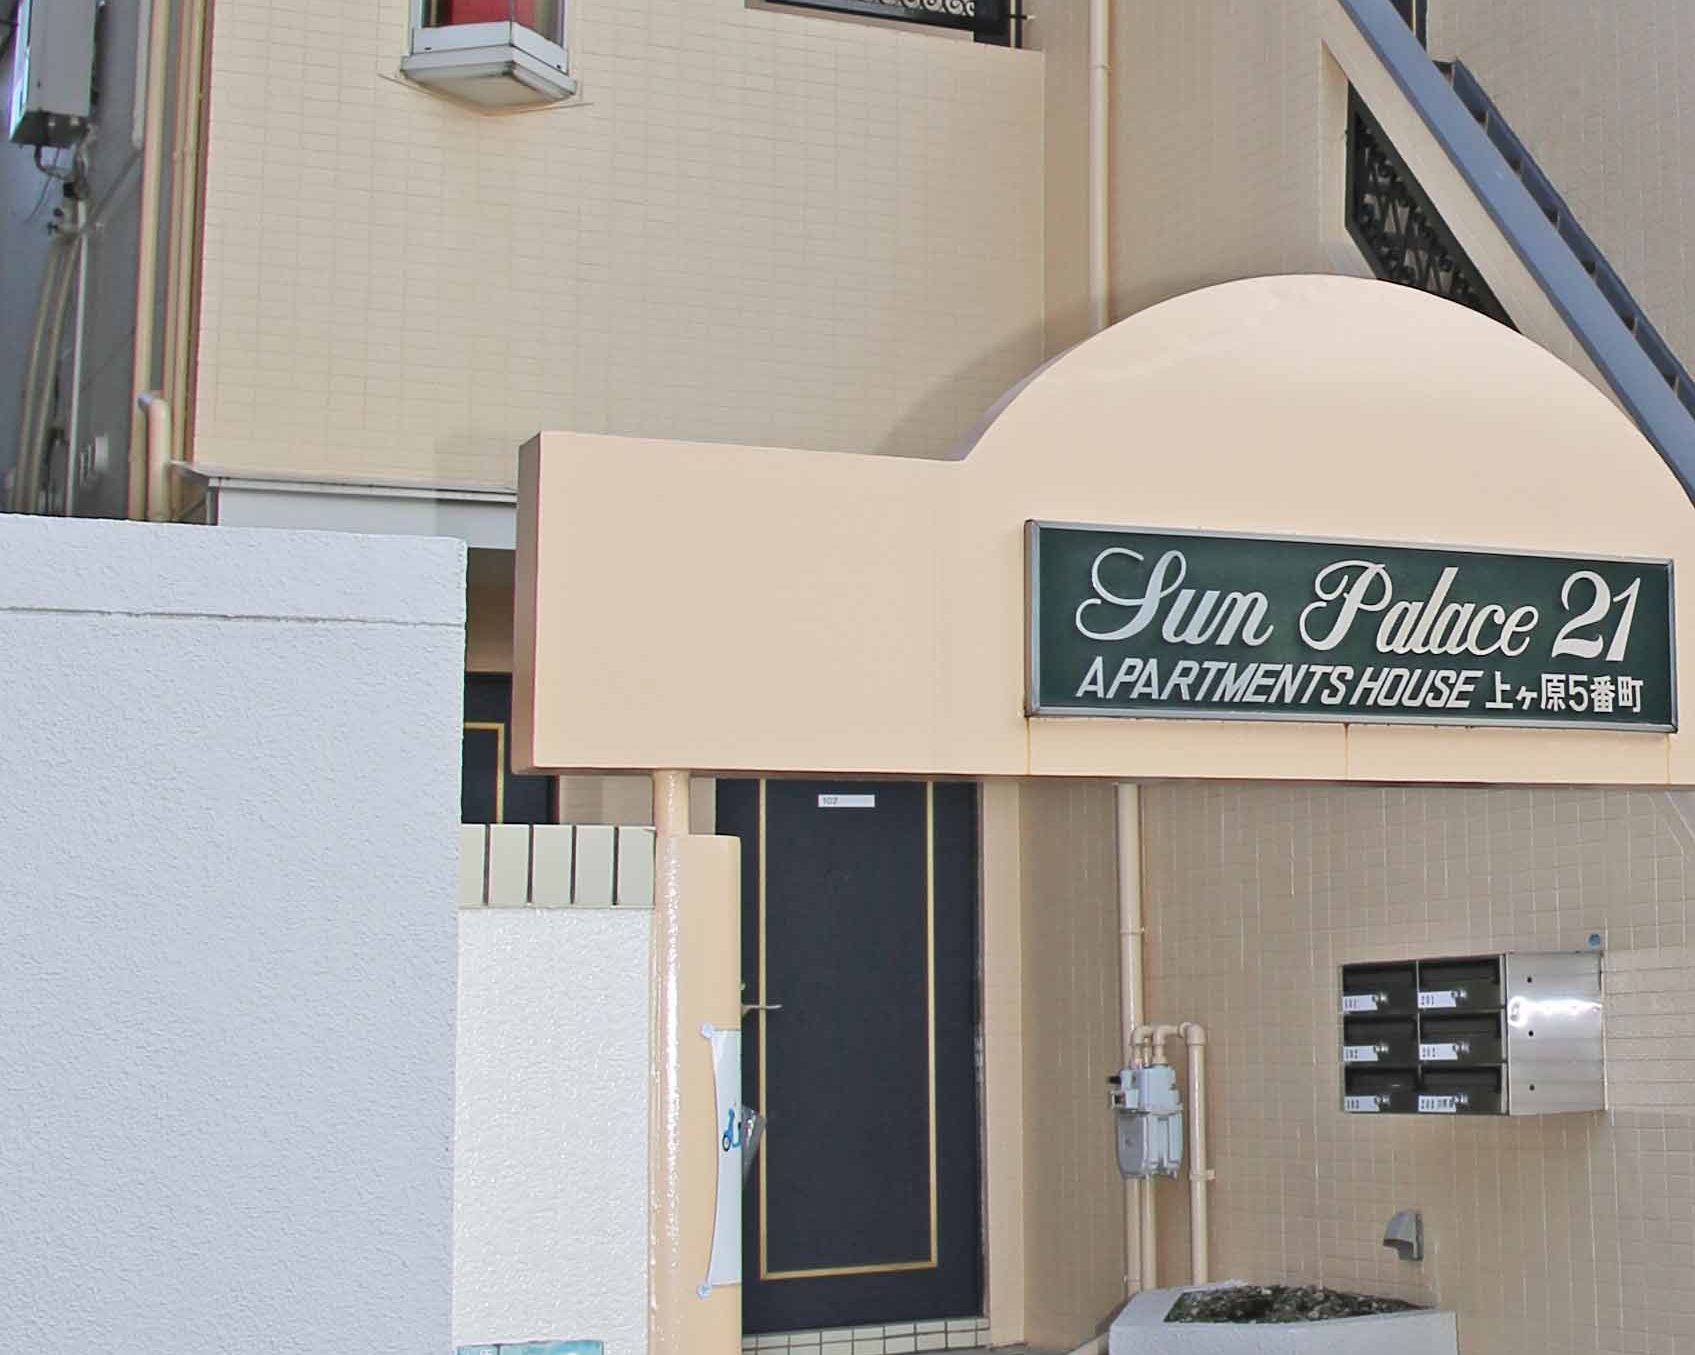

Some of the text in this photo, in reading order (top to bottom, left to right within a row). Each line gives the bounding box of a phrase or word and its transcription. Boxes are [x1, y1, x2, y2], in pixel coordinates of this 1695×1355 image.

[1075, 547, 1641, 662] Sun Palace 21
[1075, 655, 1355, 705] APARTMENTS
[1348, 666, 1485, 708] HOUSE
